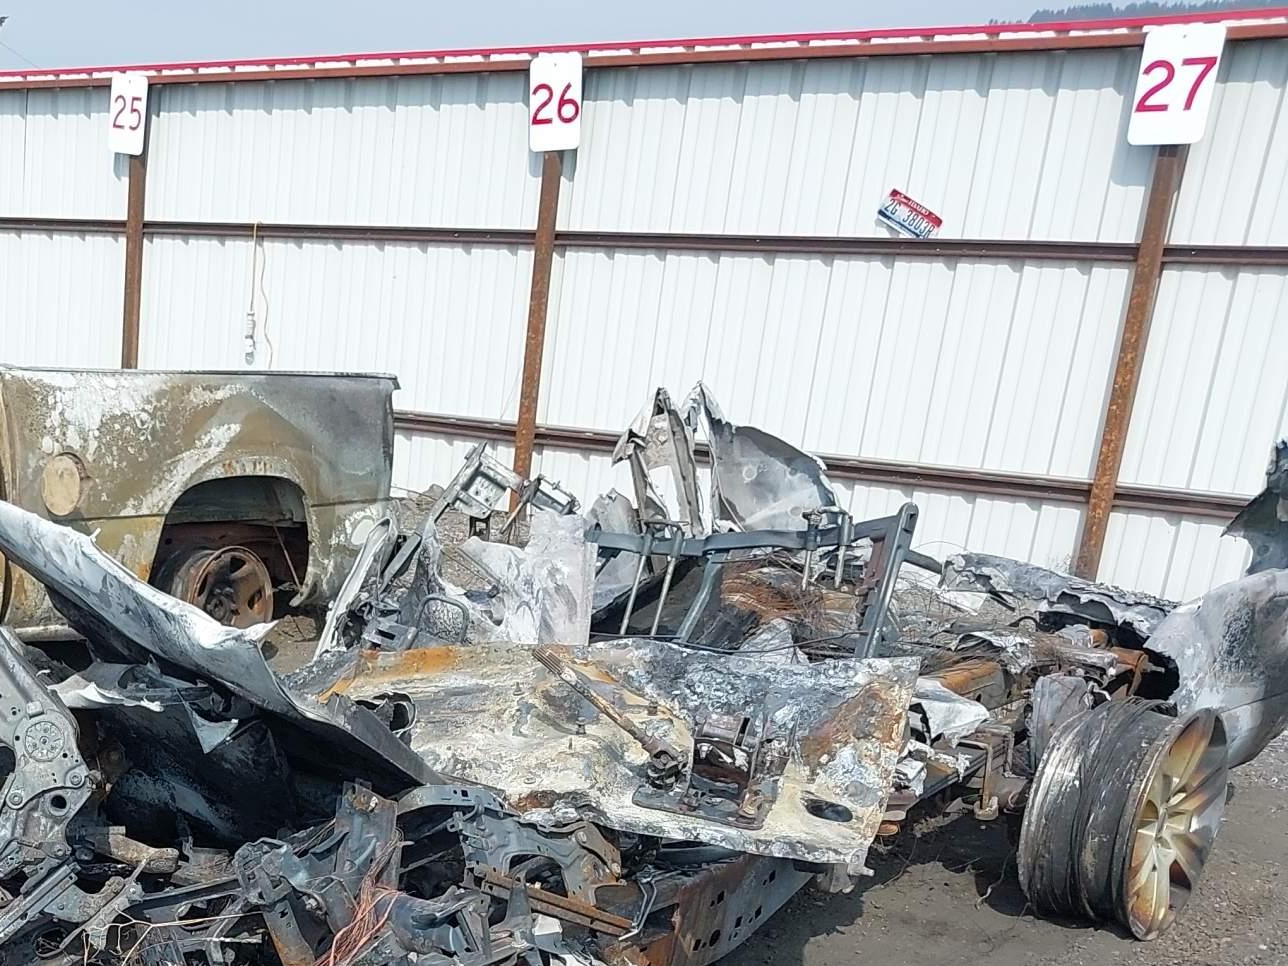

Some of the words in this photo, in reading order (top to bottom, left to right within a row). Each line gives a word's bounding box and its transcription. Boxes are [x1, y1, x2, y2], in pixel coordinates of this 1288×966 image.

[531, 82, 579, 125] 26
[1134, 56, 1218, 113] 27
[113, 94, 142, 131] 25
[884, 198, 901, 215] 2G
